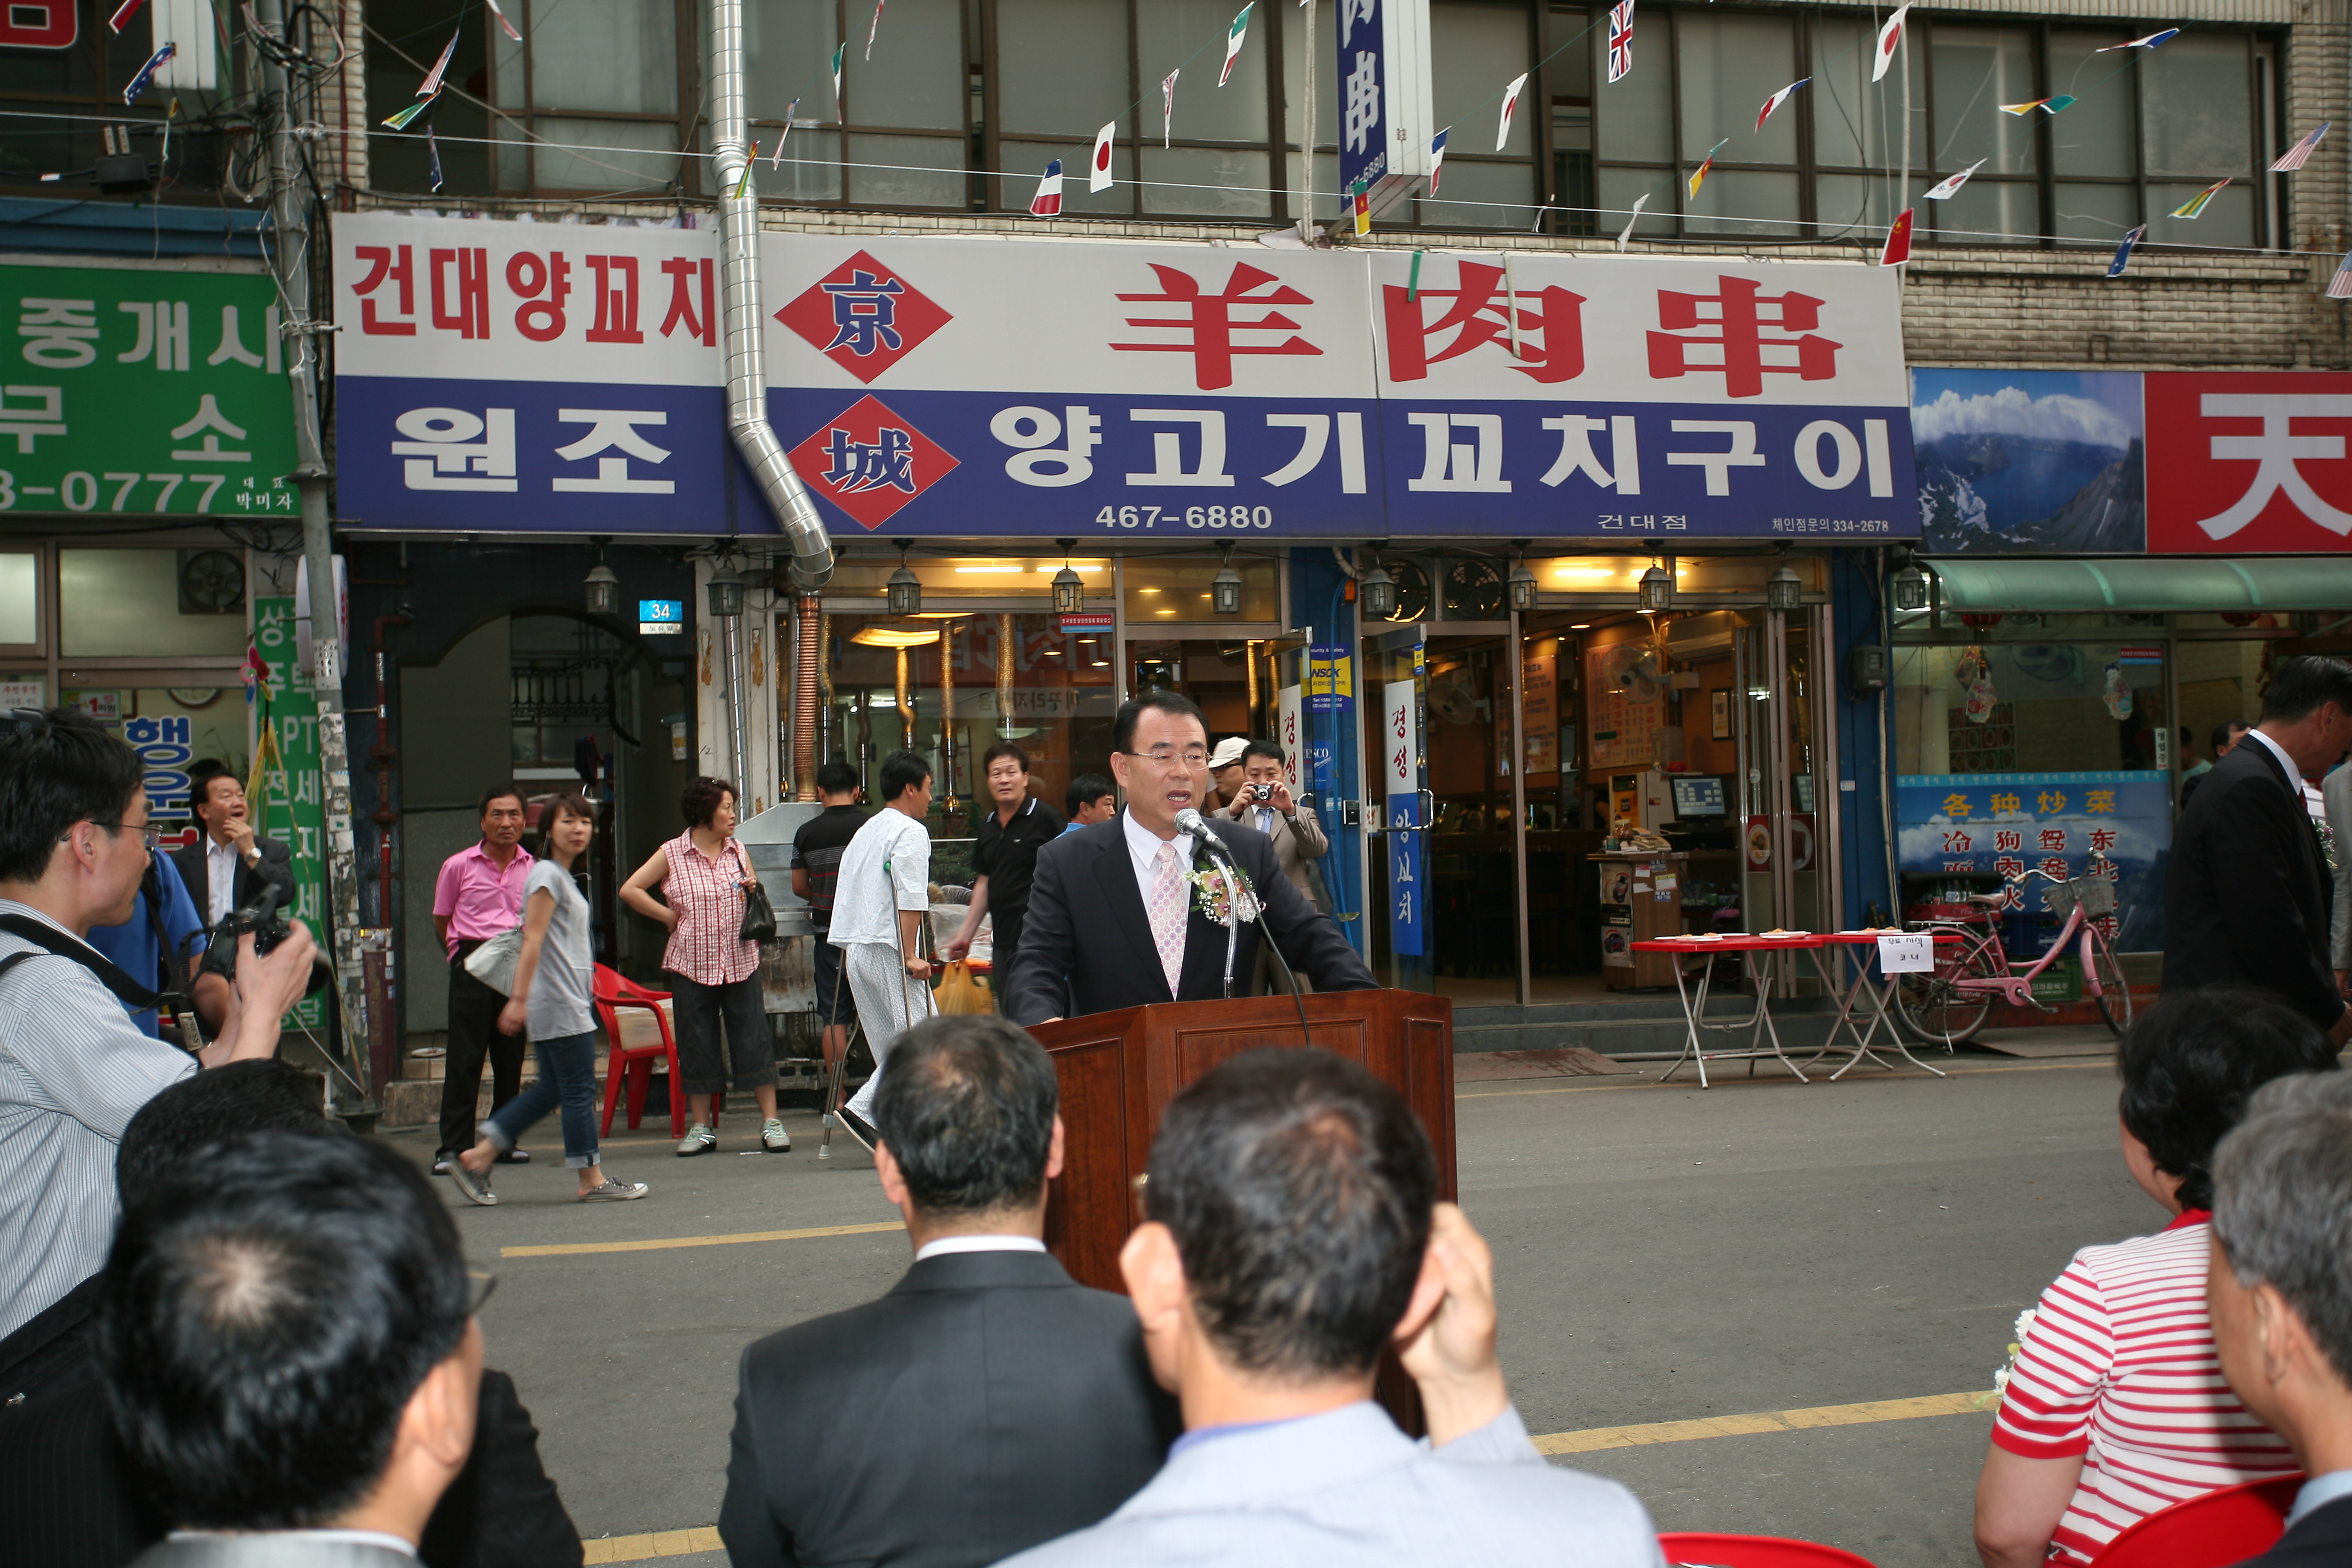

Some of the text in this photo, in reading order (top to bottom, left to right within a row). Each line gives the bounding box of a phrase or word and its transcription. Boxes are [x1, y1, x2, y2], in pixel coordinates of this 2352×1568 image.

[351, 244, 716, 347] 건대양꼬치
[819, 268, 905, 357] 京
[1108, 260, 1844, 398] 羊肉串
[391, 407, 675, 494] 원조
[820, 426, 916, 494] 城
[2196, 393, 2352, 541] 天
[236, 492, 293, 510] 박미자
[1095, 505, 1272, 530] 467-6880
[1598, 514, 1688, 531] 건대점
[1772, 517, 1889, 533] 체인점문의 334-2678
[652, 604, 670, 619] 34
[1392, 704, 1408, 779] 경성
[1941, 789, 2116, 817] 各种炒菜
[1395, 808, 1413, 925] 양꼬치
